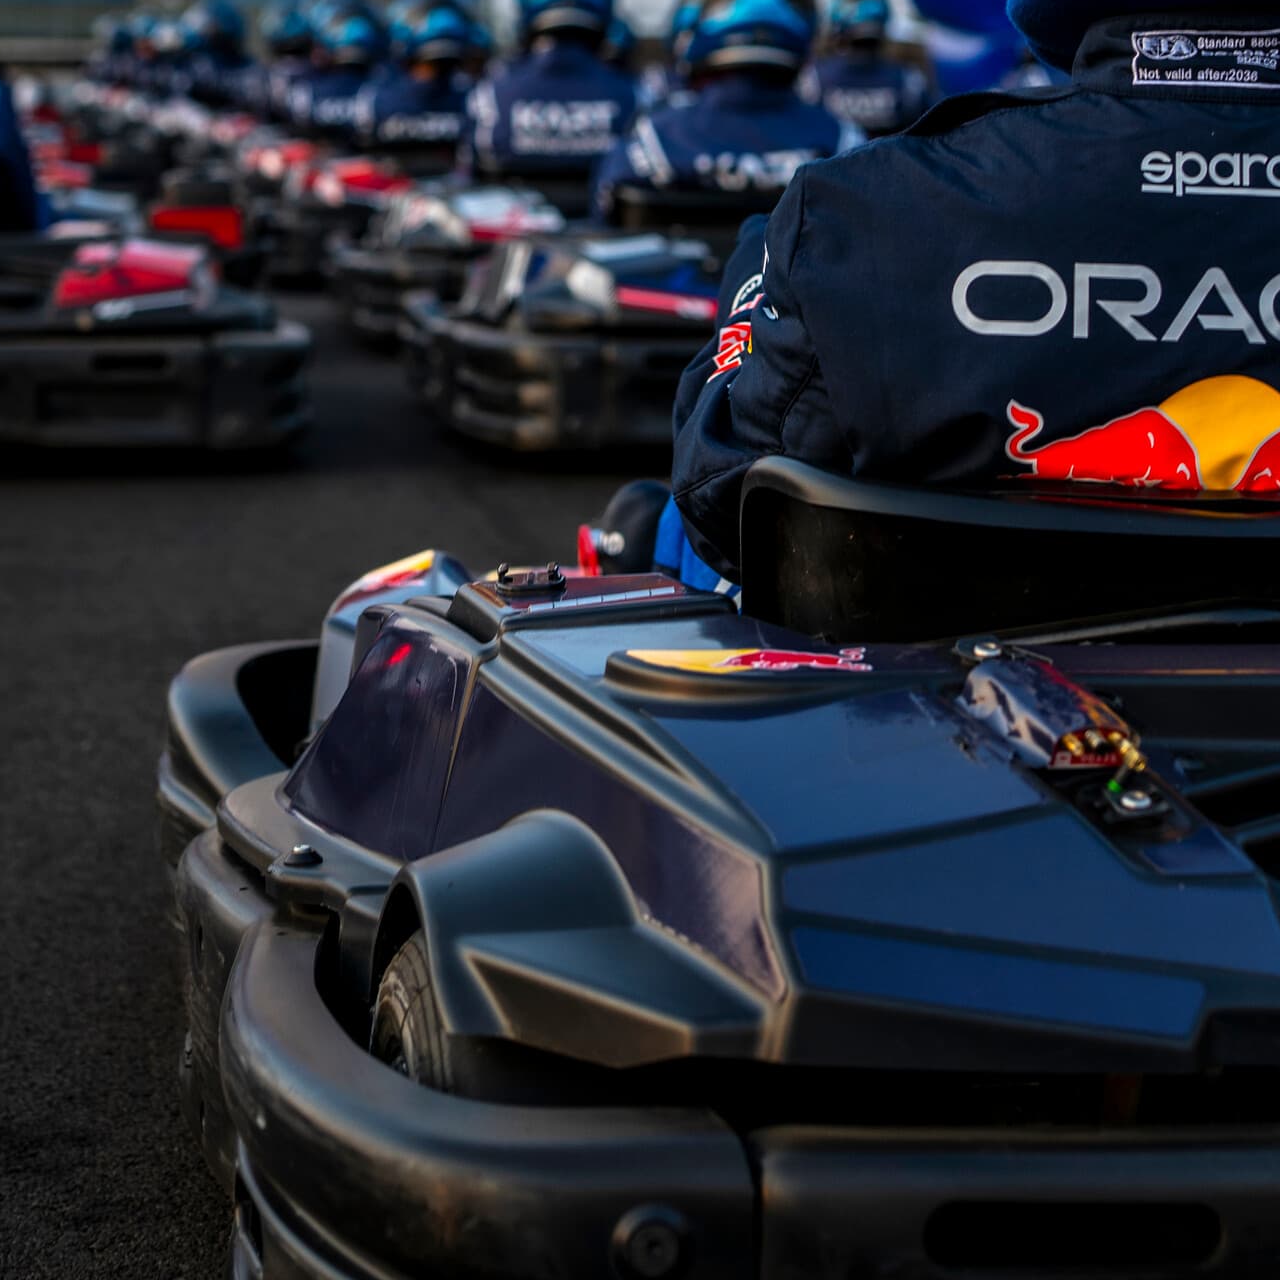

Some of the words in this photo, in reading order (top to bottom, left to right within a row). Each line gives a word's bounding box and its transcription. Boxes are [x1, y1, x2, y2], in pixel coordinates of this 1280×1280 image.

[1196, 36, 1246, 50] Standard
[1138, 68, 1161, 80] Not
[1165, 68, 1192, 81] valid
